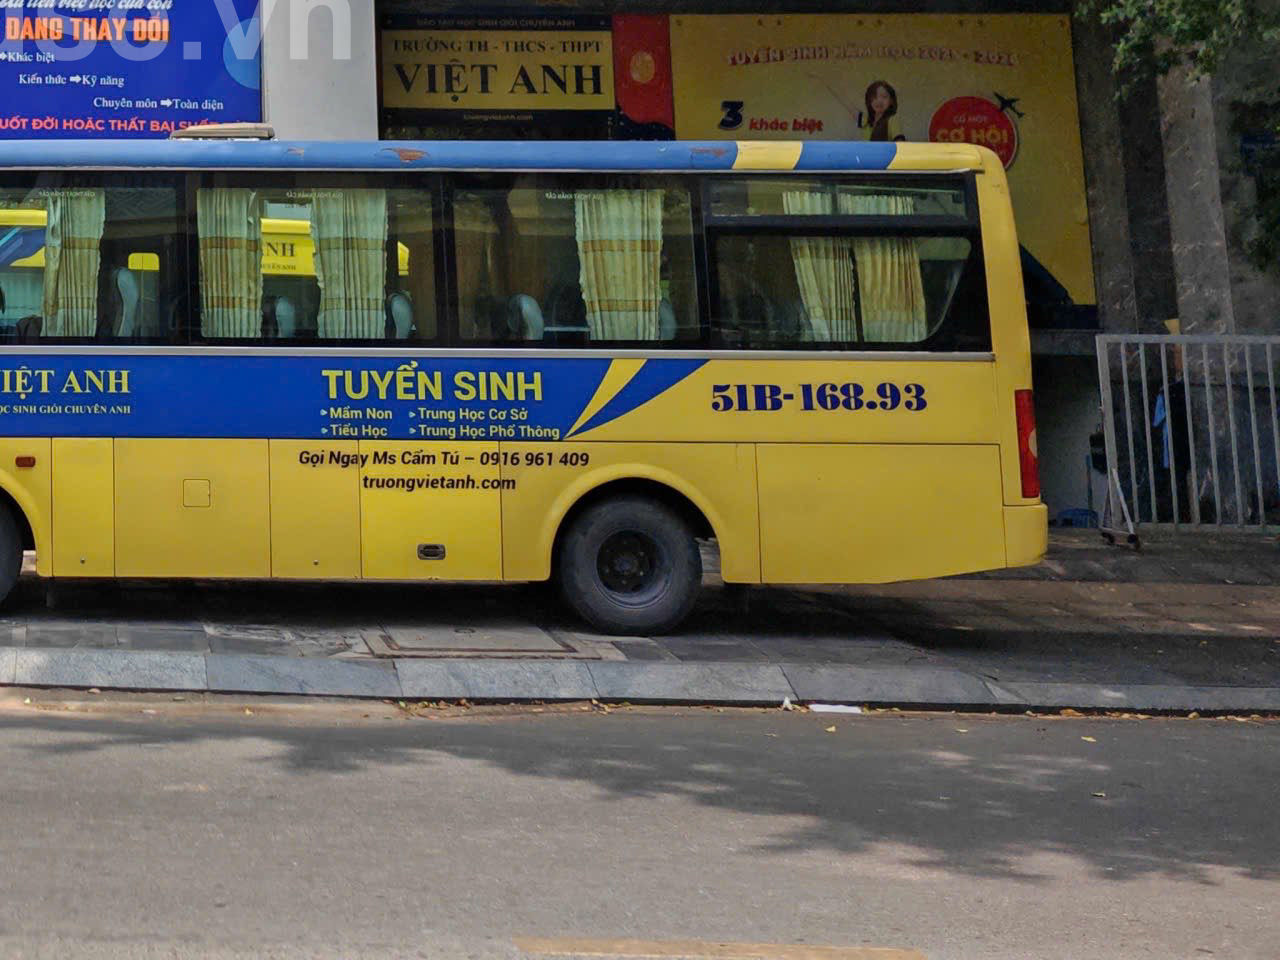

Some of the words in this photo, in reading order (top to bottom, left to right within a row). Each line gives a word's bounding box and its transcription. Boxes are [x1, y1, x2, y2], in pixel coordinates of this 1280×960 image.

[70, 17, 126, 41] THAY
[393, 36, 462, 52] TRƯỜNG
[468, 40, 489, 52] TH
[503, 40, 546, 53] THCS
[559, 40, 602, 53] THPT
[8, 51, 33, 62] Khác
[36, 51, 55, 64] biệt
[19, 73, 42, 84] Kiến
[45, 73, 67, 84] thức
[82, 74, 97, 87] Kỹ
[100, 76, 125, 88] năng
[393, 58, 498, 103] VIỆT
[509, 64, 603, 95] ANH
[93, 97, 133, 110] Chuyên
[136, 98, 158, 108] môn
[172, 98, 199, 110] Toàn
[201, 98, 224, 111] diện
[32, 116, 58, 130] ĐỜI
[63, 118, 105, 133] HOẶC
[109, 116, 146, 131] THẤT
[718, 100, 744, 130] 3
[749, 117, 788, 131] khác
[792, 117, 824, 134] biệt
[61, 370, 131, 394] ANH
[321, 360, 443, 401] TUYỂN
[454, 371, 543, 401] SINH
[711, 382, 928, 412] 51B-168.93
[13, 405, 37, 414] SINH
[39, 403, 62, 414] GIỎI
[64, 403, 107, 414] CHUYÊN
[109, 405, 131, 414] ANH
[366, 407, 393, 420] Non
[418, 408, 455, 423] Trung
[459, 408, 485, 422] Học
[488, 408, 508, 421] Cơ
[510, 408, 528, 421] Sở
[330, 423, 359, 437] Tiểu
[362, 424, 388, 439] Học
[418, 425, 456, 440] Trung
[459, 425, 486, 439] Học
[489, 424, 515, 438] Phổ
[517, 425, 560, 441] Thông
[299, 450, 325, 468] Gọi
[328, 451, 368, 469] Ngay
[373, 451, 397, 465] Ms
[441, 450, 460, 465] Tú
[480, 452, 520, 466] 0916
[524, 452, 554, 466] 961
[559, 452, 590, 467] 409
[362, 474, 516, 493] truongvietanh.com
